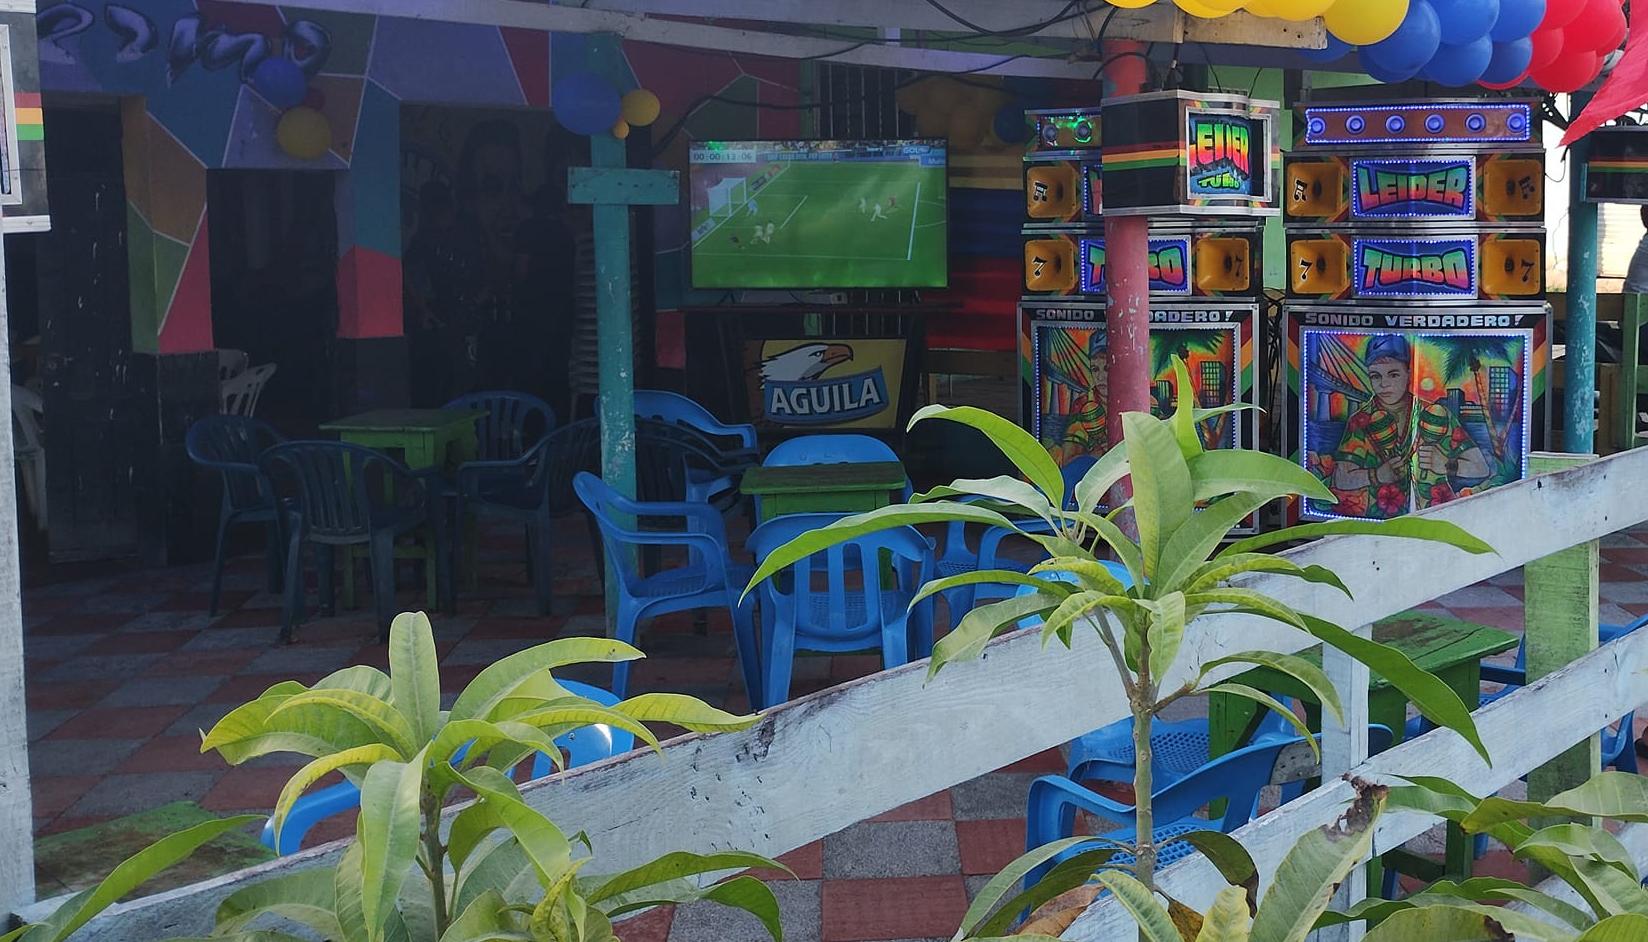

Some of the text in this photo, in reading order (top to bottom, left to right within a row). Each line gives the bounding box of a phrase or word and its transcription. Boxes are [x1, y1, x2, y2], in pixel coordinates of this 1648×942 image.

[1356, 165, 1469, 212] LEIDER
[1361, 247, 1471, 291] TURBO
[1035, 308, 1095, 321] SONIDO
[1305, 312, 1374, 326] SONIDO
[770, 377, 881, 415] AGUILA
